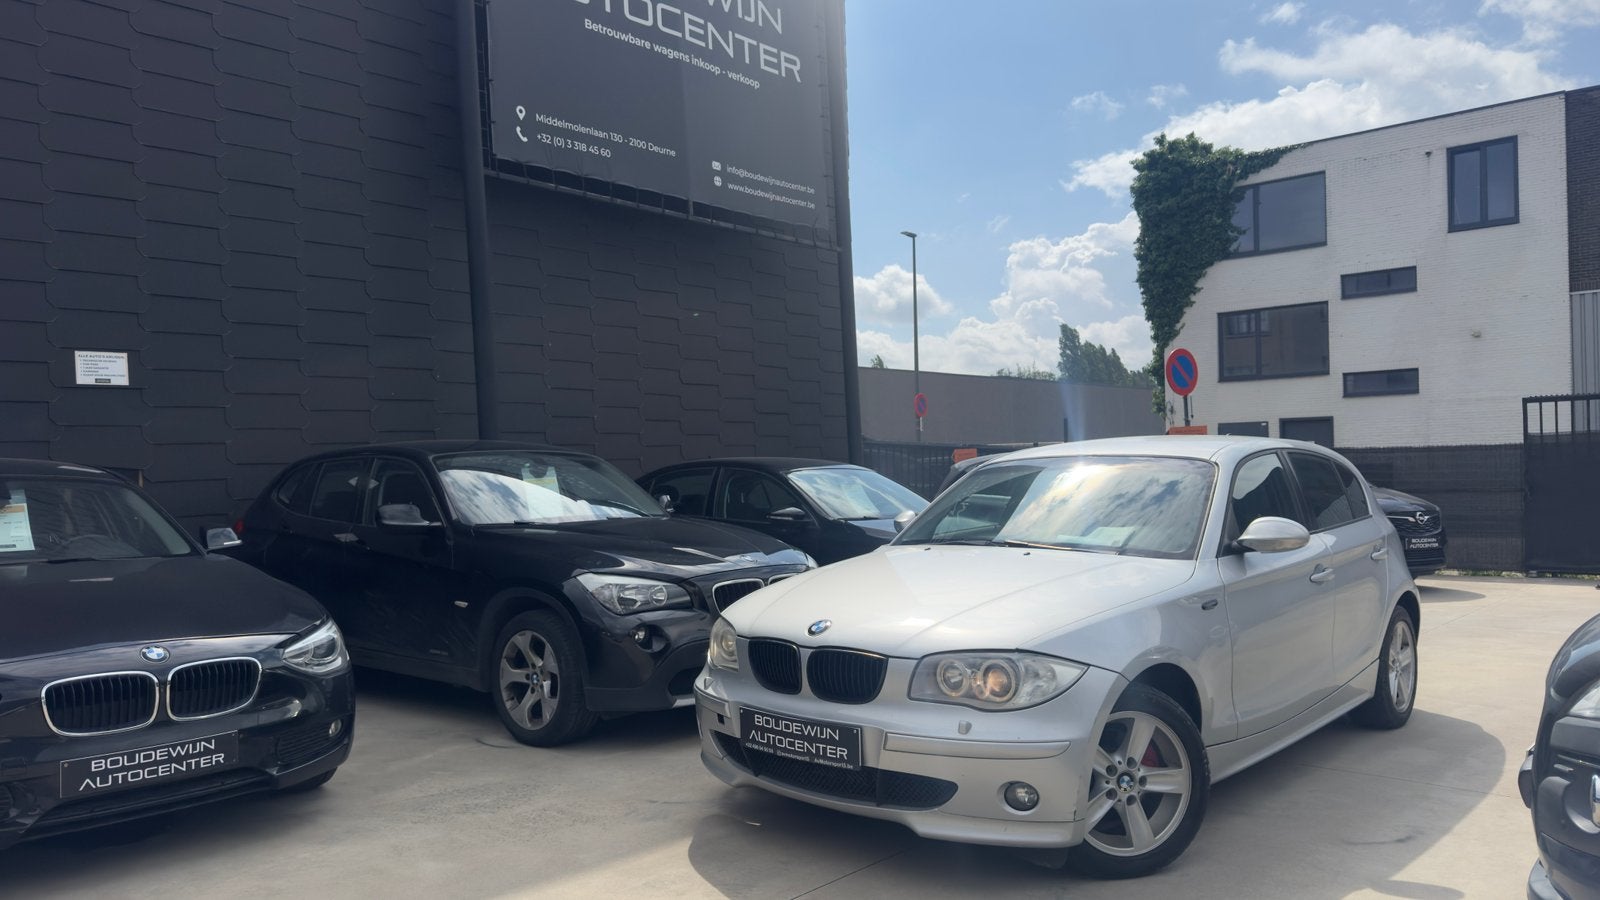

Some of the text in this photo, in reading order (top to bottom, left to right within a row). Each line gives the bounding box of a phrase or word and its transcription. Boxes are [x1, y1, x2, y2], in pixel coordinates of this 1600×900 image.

[576, 0, 802, 83] OCENTER
[584, 18, 651, 50] Betrouwbare
[653, 43, 690, 63] wagens
[691, 54, 721, 76] inkoop
[727, 70, 761, 90] verkoop
[535, 113, 609, 140] Middelmolenlaan
[609, 131, 623, 144] 130
[629, 137, 647, 150] 2100
[648, 142, 676, 157] Deurne
[536, 133, 612, 158] +32 (0) 3 318 45 60
[726, 163, 815, 195] info@boudewijnautocenter.be
[727, 182, 816, 210] www.boudewijnautocenter.be
[754, 714, 839, 741] BOUDEWIJN
[91, 739, 215, 772] BOUDEWIJN
[749, 730, 848, 760] AUTOCENTER
[79, 753, 225, 792] AUTOCENTER
